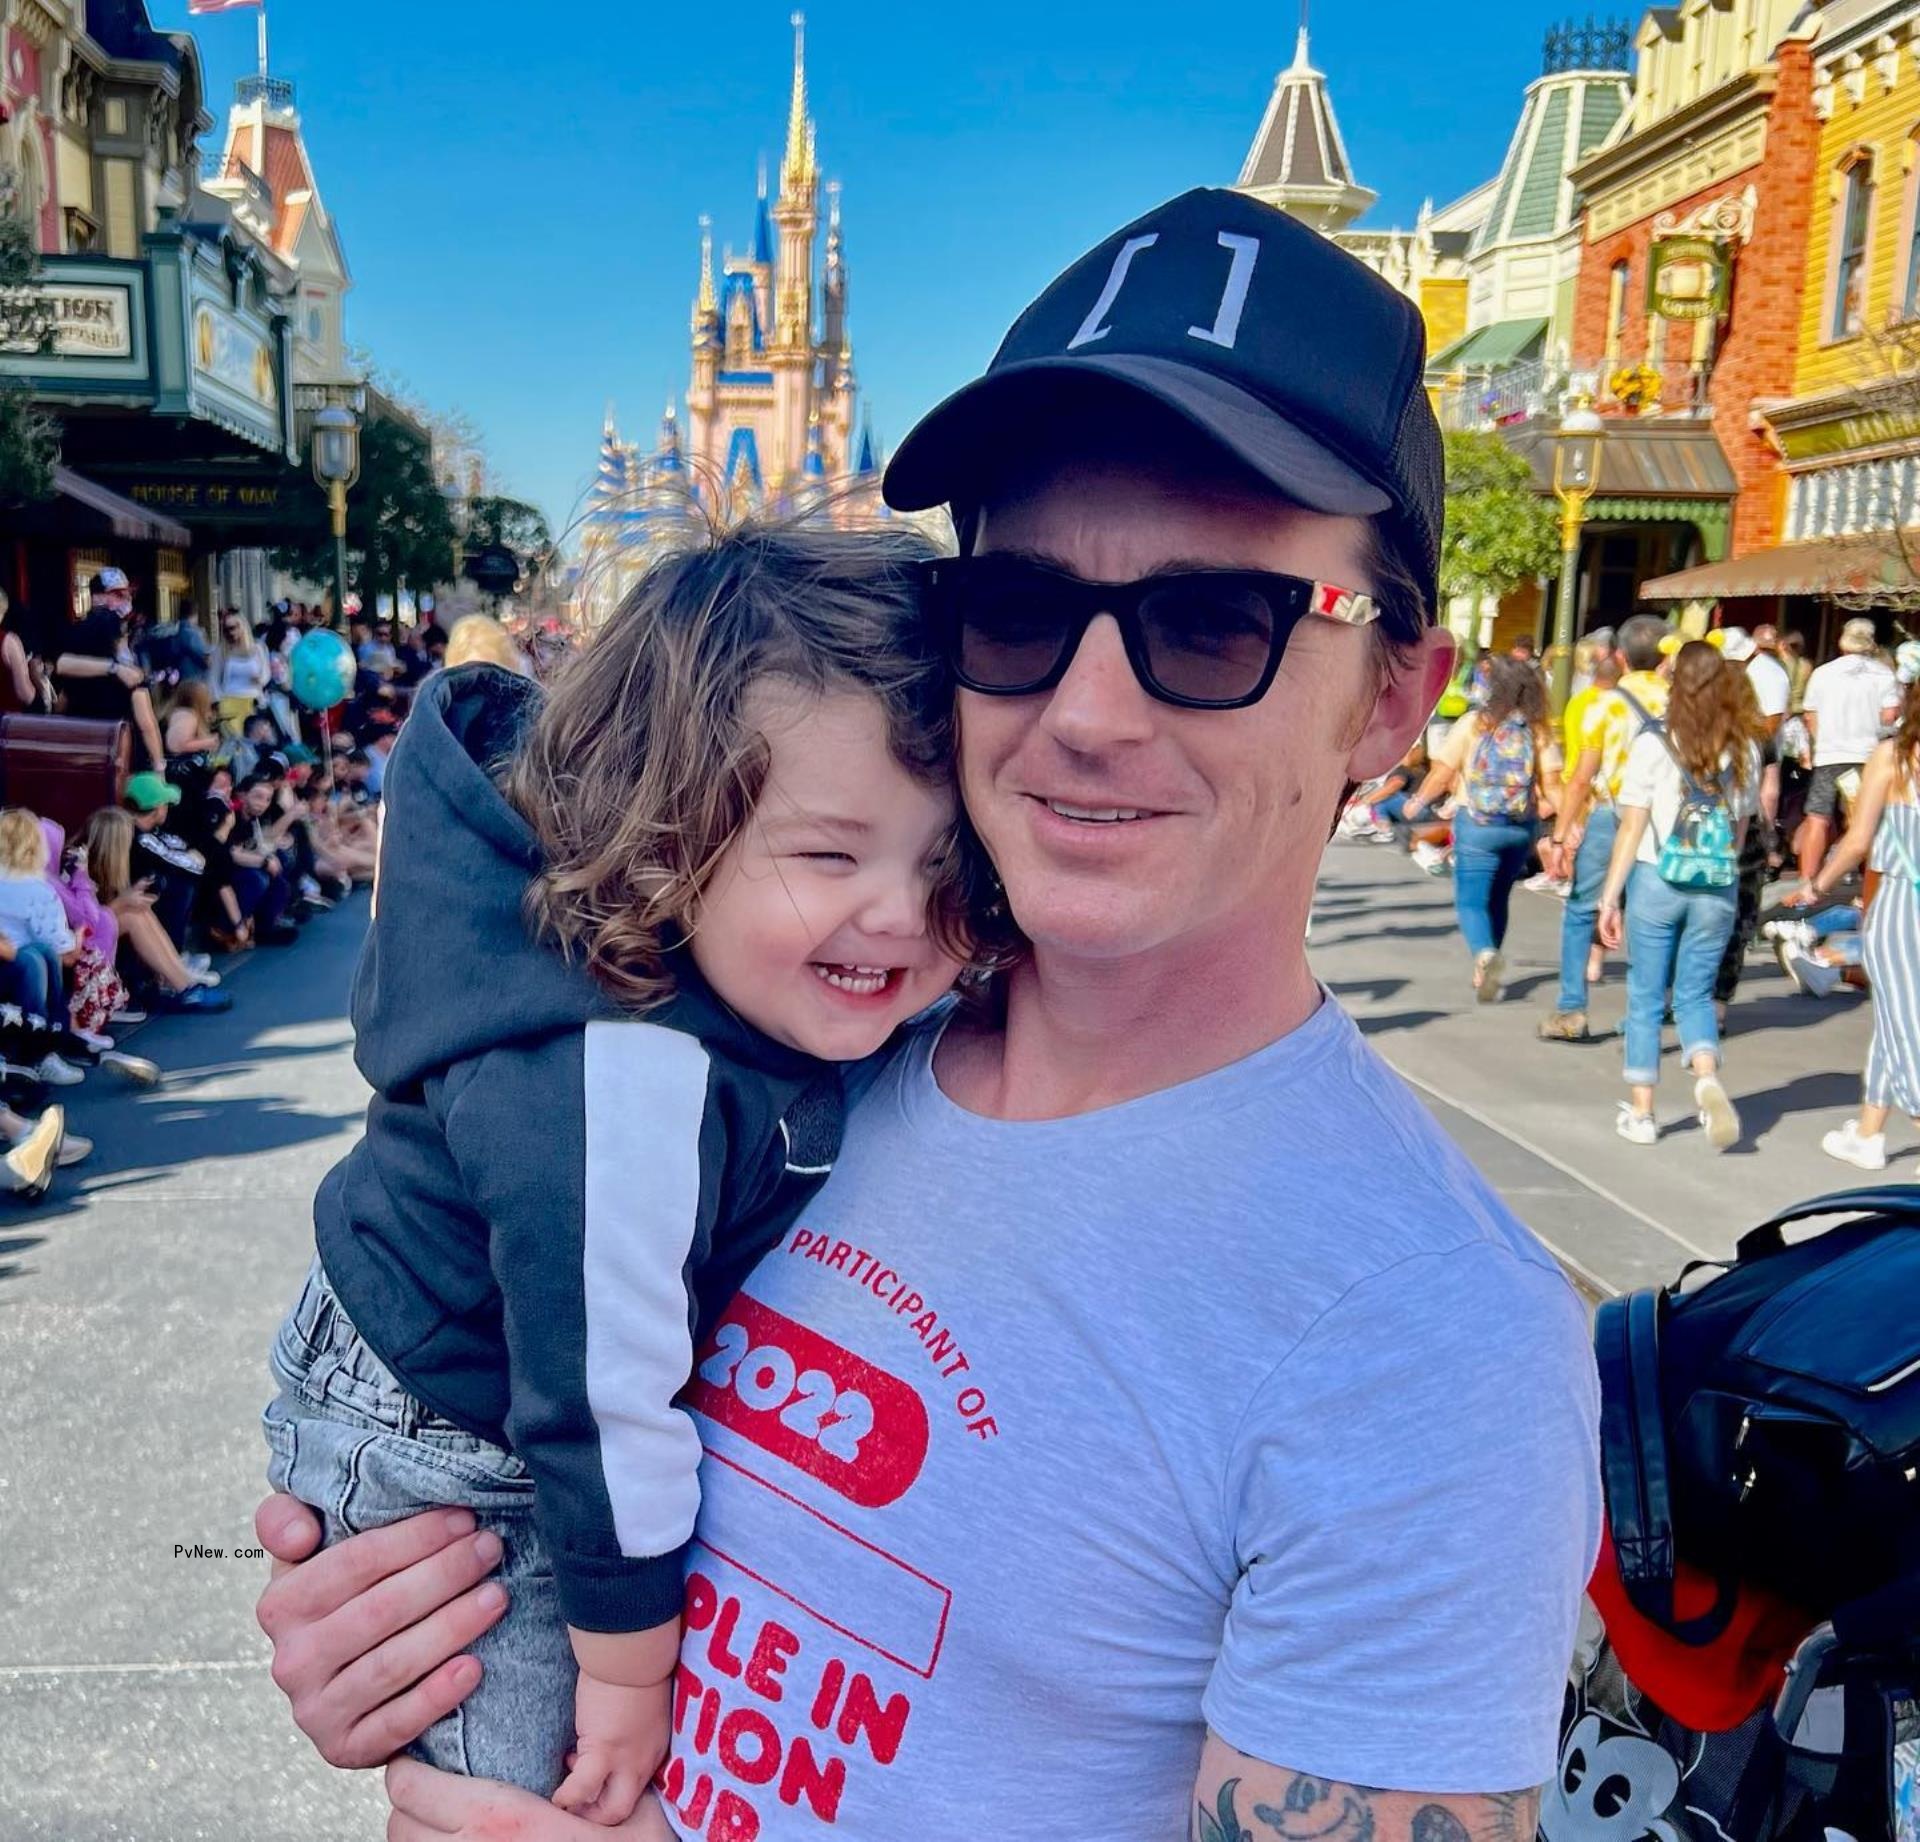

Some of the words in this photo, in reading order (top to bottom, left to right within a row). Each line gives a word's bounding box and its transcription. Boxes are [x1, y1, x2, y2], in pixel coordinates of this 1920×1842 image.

[699, 1322, 874, 1464] 2022
[788, 1228, 970, 1378] PARTICIPANT
[956, 1386, 998, 1441] OF
[673, 1660, 847, 1824] TION
[811, 1658, 911, 1766] IN
